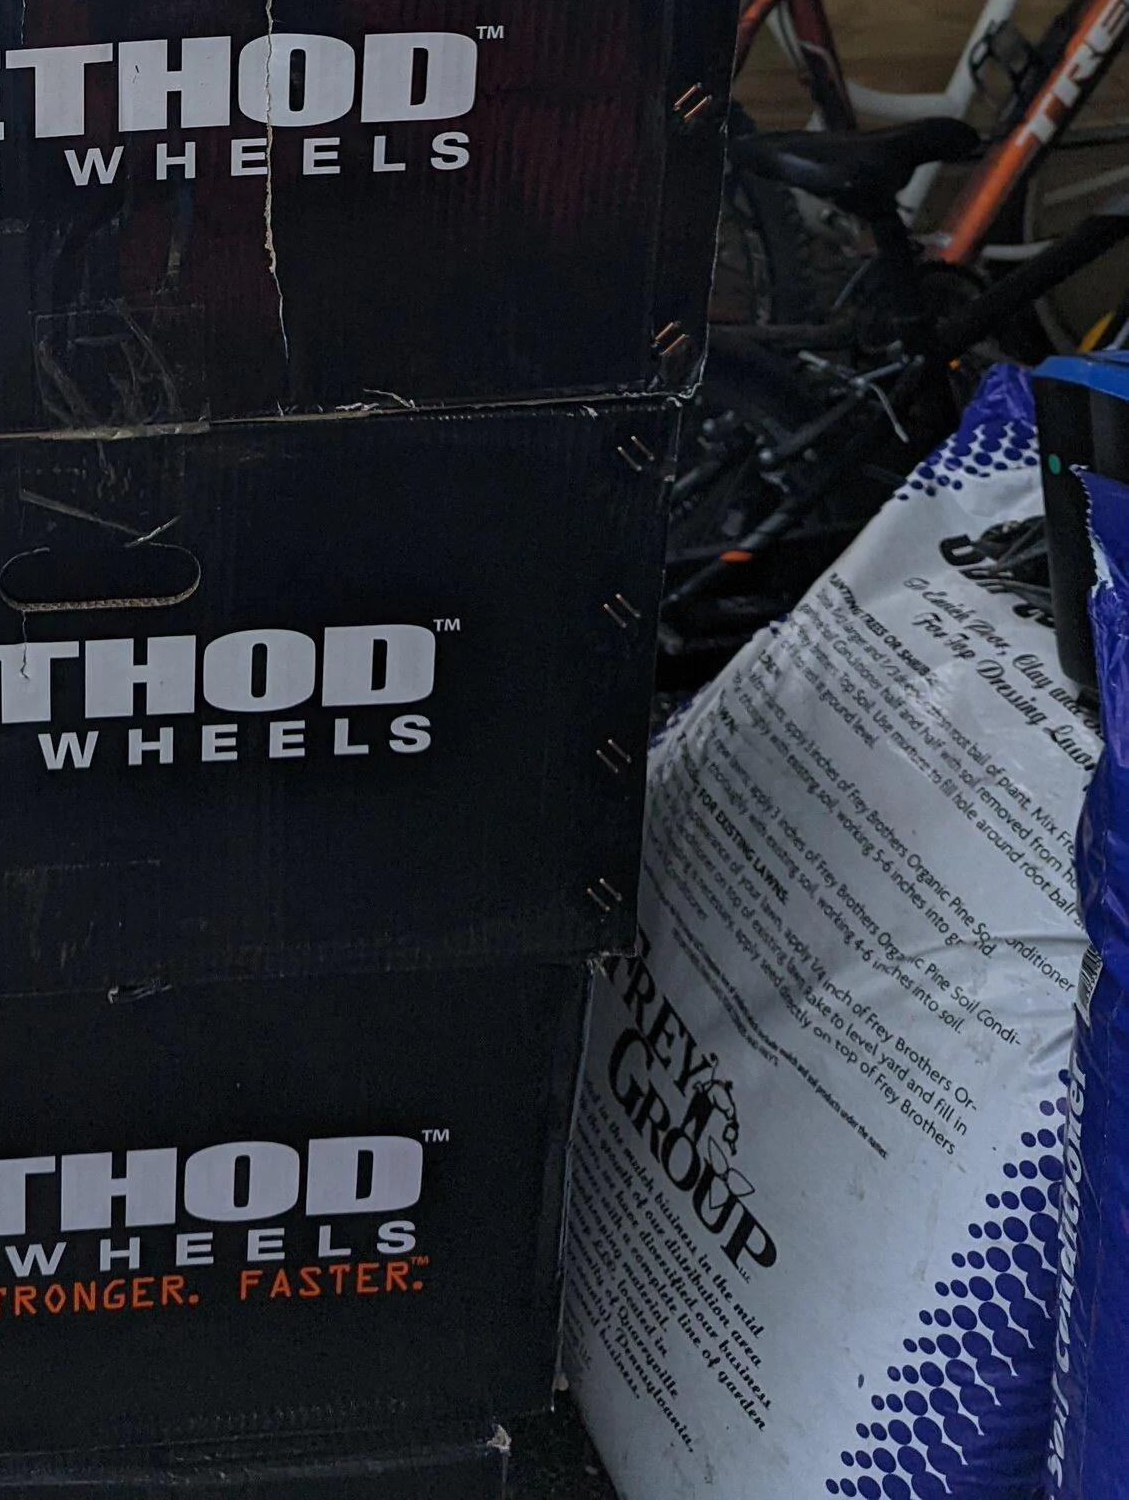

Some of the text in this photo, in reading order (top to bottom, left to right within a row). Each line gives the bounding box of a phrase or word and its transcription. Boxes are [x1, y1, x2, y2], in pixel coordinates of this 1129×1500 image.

[64, 131, 472, 187] WHEELS
[861, 613, 903, 651] TREES OR
[922, 591, 976, 623] Enrich
[1012, 653, 1053, 690] Clay
[977, 659, 1047, 726] Dressing
[37, 714, 433, 772] WHEELS
[697, 787, 718, 815] FOR
[872, 709, 894, 734] Use
[951, 791, 978, 821] hole
[976, 820, 1025, 863] around
[1019, 861, 1052, 891] root
[880, 686, 906, 710] half
[898, 708, 924, 731] and
[918, 726, 947, 751] half
[976, 786, 1033, 840] removed
[1029, 836, 1063, 872] from
[966, 743, 992, 766] ball
[985, 764, 1006, 778] of
[995, 776, 1032, 811] plant.
[836, 779, 856, 792] of
[847, 785, 869, 815] Frey
[866, 809, 908, 858] Brothers
[906, 853, 950, 901] Organic
[948, 896, 975, 927] Pine
[836, 810, 875, 857] working
[872, 848, 894, 873] 5-6
[890, 871, 926, 910] inches
[924, 907, 950, 934] into
[1030, 806, 1058, 835] Mix
[804, 849, 821, 863] of
[816, 859, 838, 888] Frey
[836, 883, 879, 936] Brothers
[924, 962, 951, 992] Pine
[950, 985, 981, 1014] Soil
[976, 1008, 1020, 1045] Condi-
[817, 897, 855, 945] working
[854, 939, 874, 962] 4-6
[910, 984, 939, 1012] into
[937, 1009, 965, 1034] soil.
[813, 1026, 832, 1044] on
[835, 1039, 858, 1064] top
[859, 1061, 878, 1078] of
[874, 1073, 900, 1105] Frey
[900, 1098, 955, 1155] Brothers
[821, 976, 853, 1007] inch
[851, 1003, 872, 1018] of
[864, 1012, 894, 1043] Frey
[894, 1037, 951, 1099] Brothers
[954, 1086, 977, 1110] Or-
[829, 1012, 845, 1030] to
[845, 1022, 879, 1056] level
[877, 1053, 910, 1082] yard
[906, 1078, 936, 1105] and
[933, 1097, 955, 1122] fill
[953, 1116, 968, 1136] in
[608, 1025, 778, 1270] GROUP
[5, 1220, 419, 1278] WHEELS
[238, 1262, 426, 1303] FASTER.
[632, 1191, 649, 1209] of
[644, 1210, 665, 1235] our
[664, 1230, 729, 1337] distribution
[730, 1330, 761, 1370] area
[654, 1191, 697, 1257] business
[697, 1253, 712, 1275] in
[712, 1274, 733, 1300] the
[733, 1303, 764, 1336] mid
[617, 1273, 668, 1358] located in
[630, 1238, 677, 1320] complete
[677, 1313, 701, 1345] line
[701, 1349, 721, 1368] of
[718, 1361, 765, 1429] garden
[638, 1221, 697, 1318] diversified
[695, 1311, 718, 1338] our
[718, 1332, 771, 1417] business
